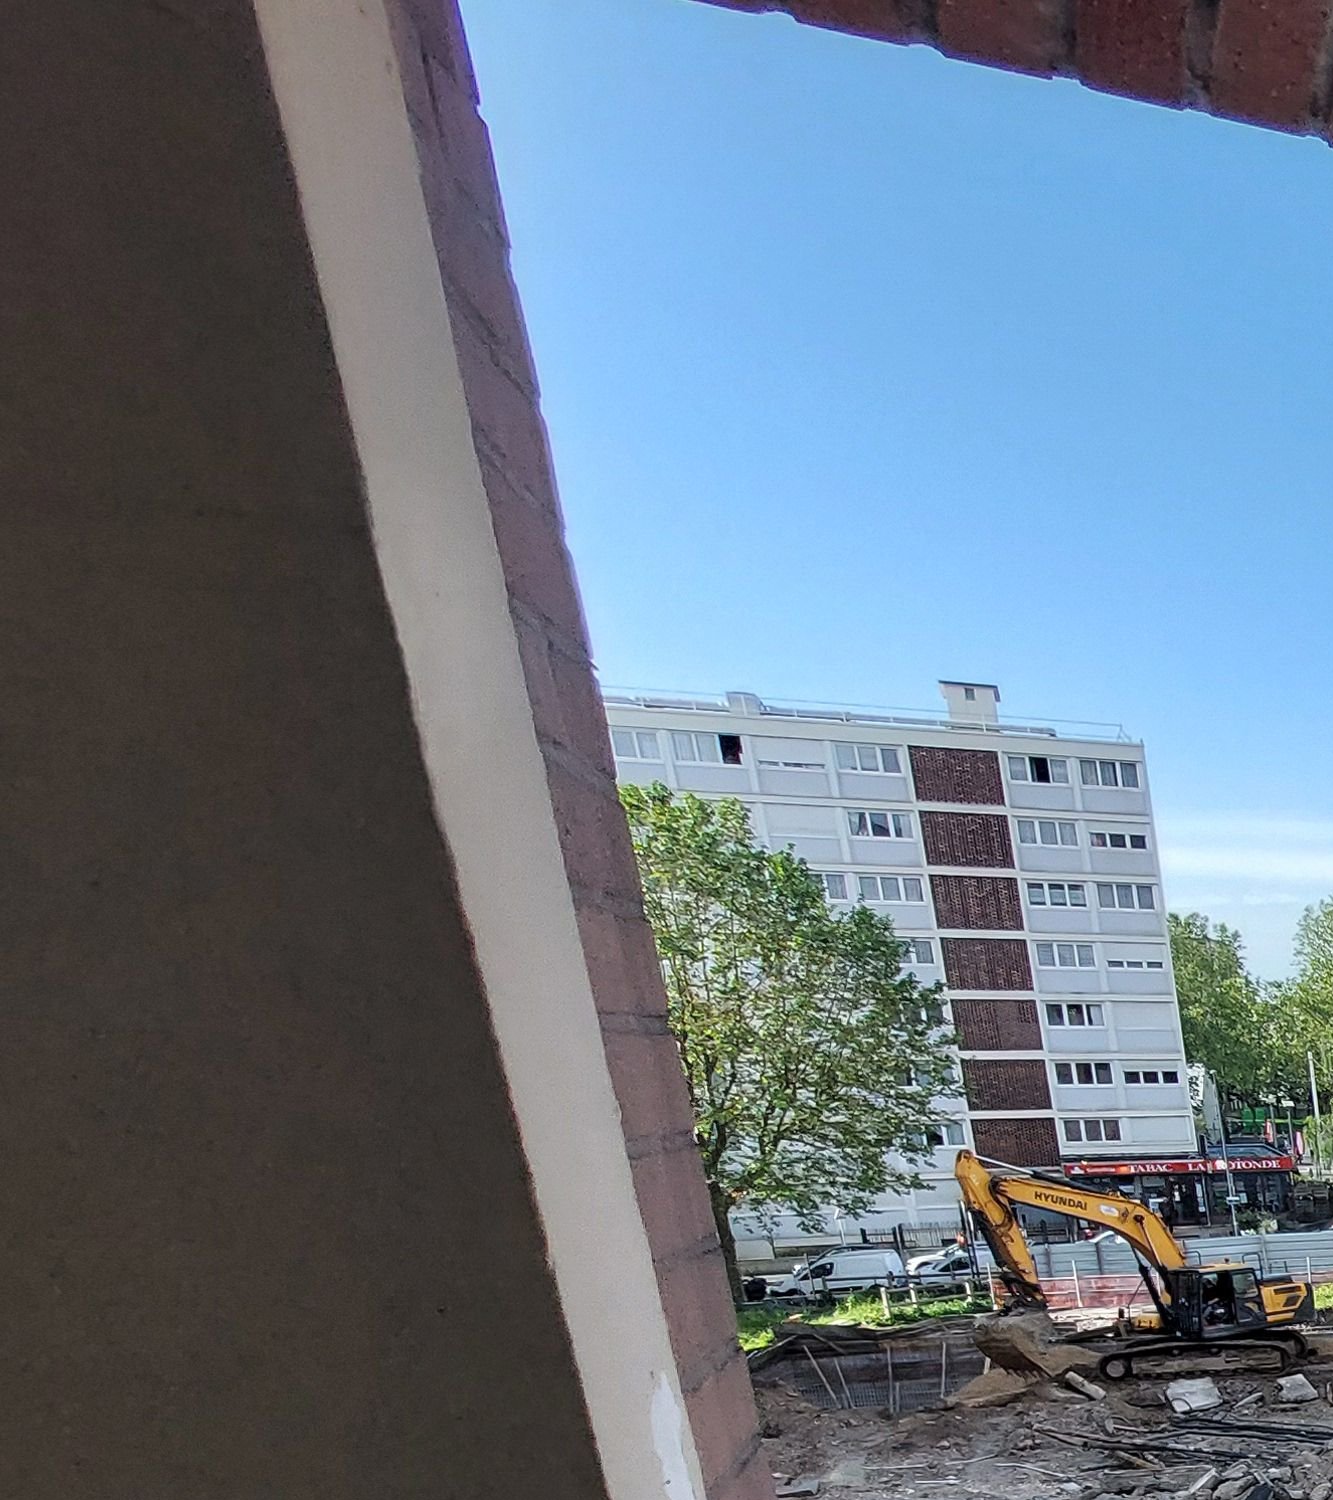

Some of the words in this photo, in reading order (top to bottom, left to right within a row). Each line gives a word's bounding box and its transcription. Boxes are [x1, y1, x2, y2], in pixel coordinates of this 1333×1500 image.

[1128, 1164, 1173, 1174] TABAC
[1188, 1163, 1206, 1172] LA
[1034, 1191, 1088, 1211] HYUNDAI
